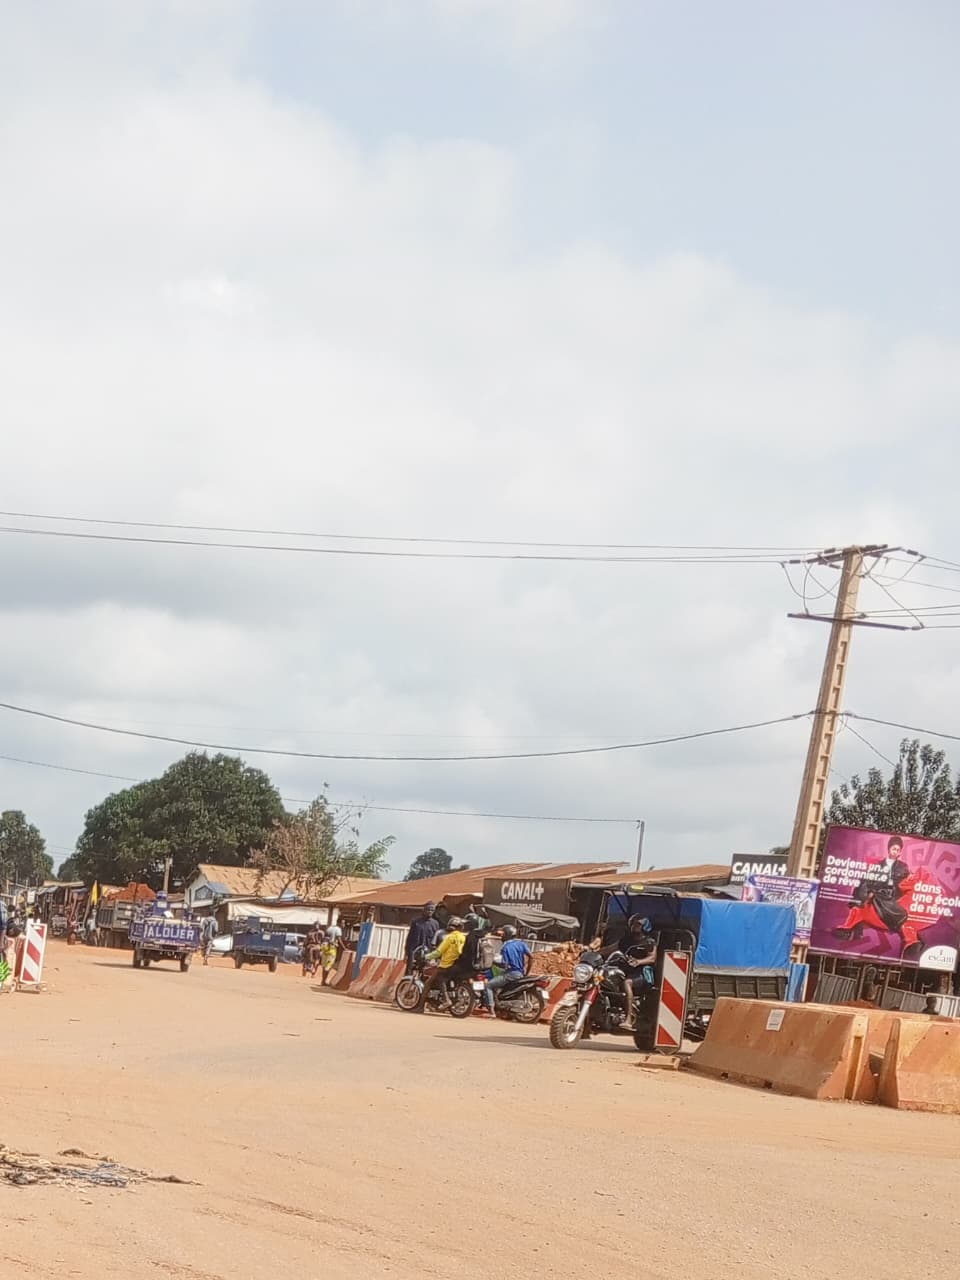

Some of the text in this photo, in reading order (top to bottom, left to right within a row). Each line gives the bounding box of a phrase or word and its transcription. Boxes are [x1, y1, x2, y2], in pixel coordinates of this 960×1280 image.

[732, 862, 788, 876] CANAL+
[827, 855, 867, 870] Deviens
[824, 865, 888, 882] cordonnier.e
[823, 874, 837, 884] de
[838, 875, 861, 888] rêve
[914, 880, 942, 894] dans
[500, 881, 544, 901] CANAL+
[912, 892, 933, 904] une
[910, 900, 925, 913] de
